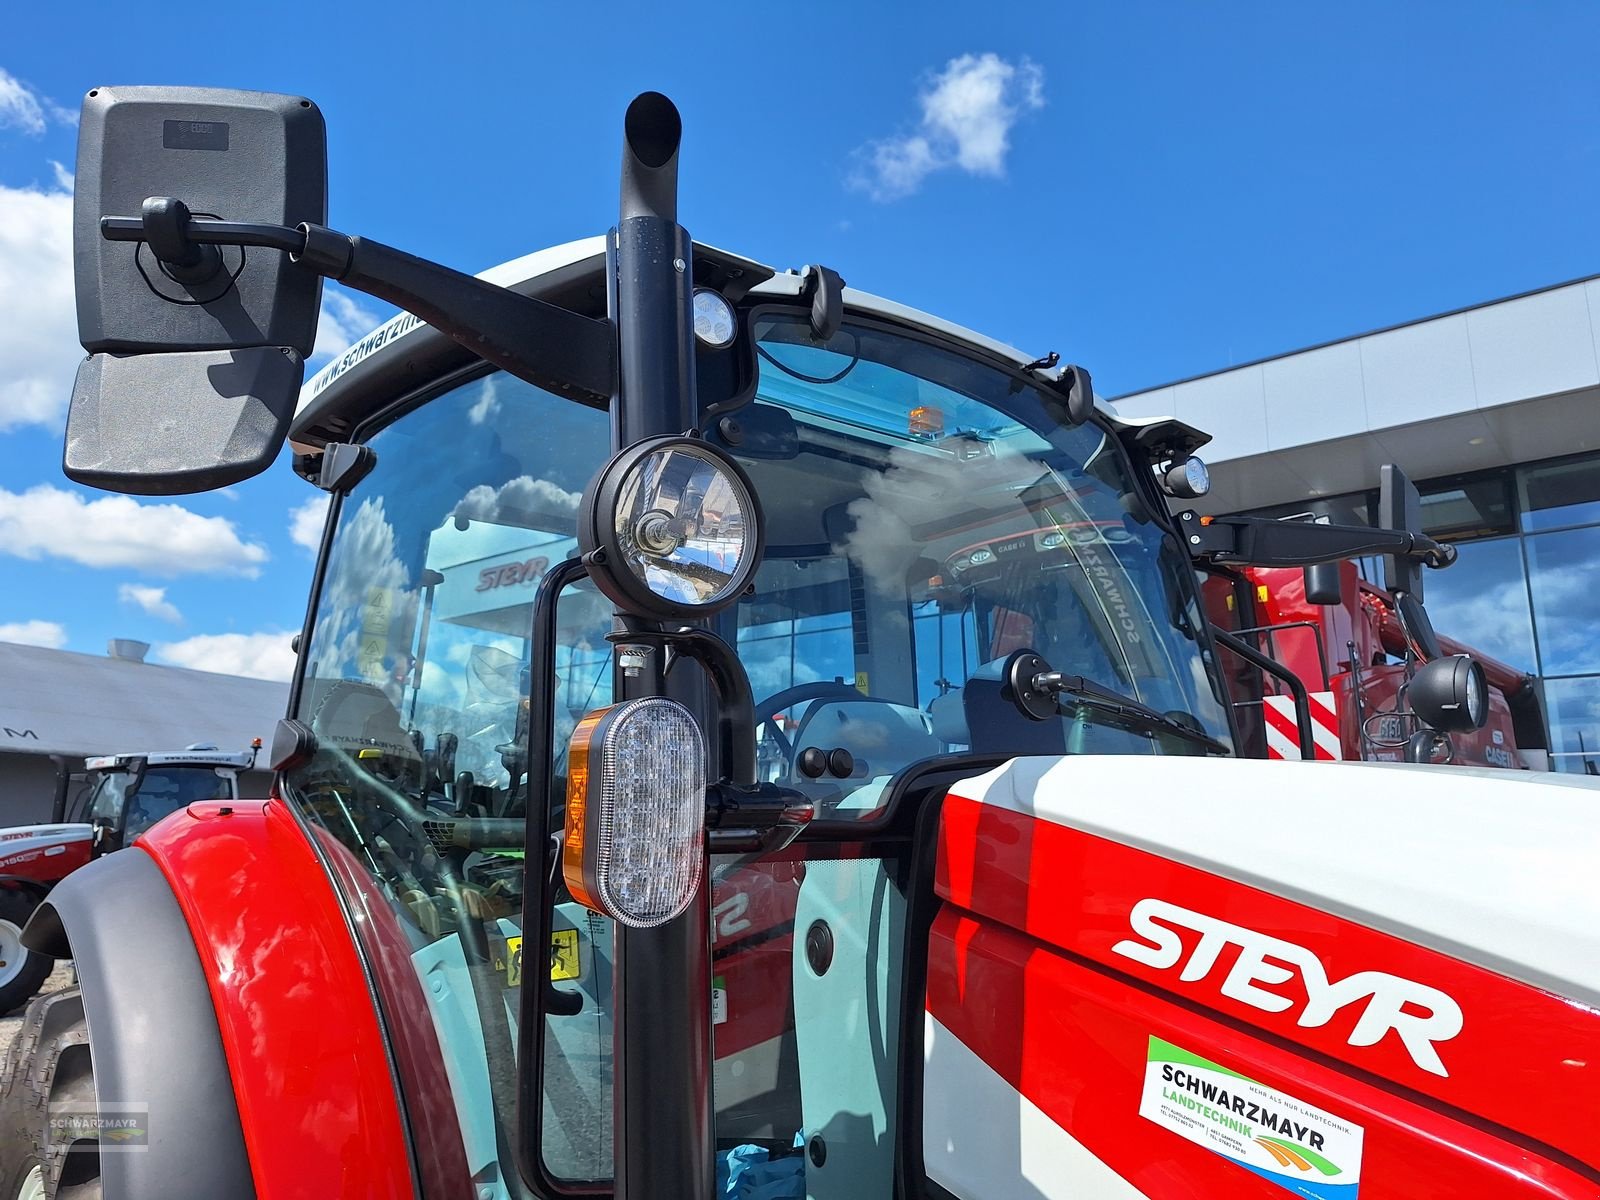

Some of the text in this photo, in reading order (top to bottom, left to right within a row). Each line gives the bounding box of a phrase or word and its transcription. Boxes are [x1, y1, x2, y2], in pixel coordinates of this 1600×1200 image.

[475, 556, 549, 592] STEYR
[1111, 897, 1465, 1078] STEYR
[1161, 1064, 1325, 1152] SCHWARZMAYR
[1162, 1086, 1253, 1139] LANDTECHNIK
[1249, 1086, 1352, 1135] MEHR ALS NUR LANDTECHNIK.
